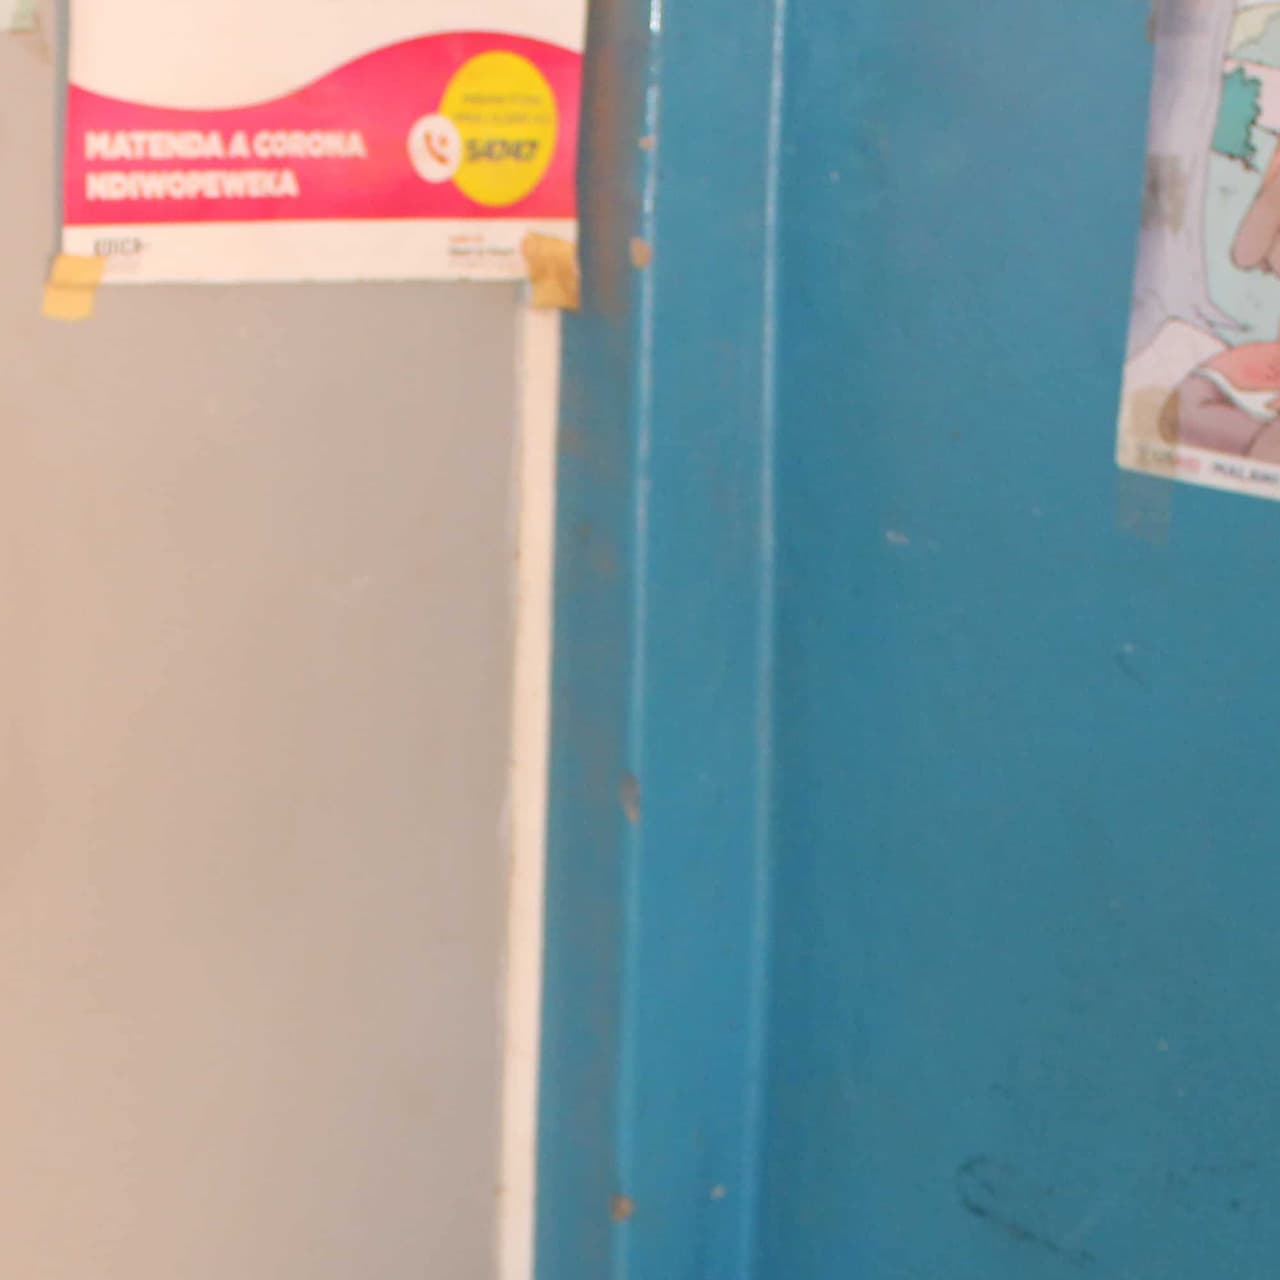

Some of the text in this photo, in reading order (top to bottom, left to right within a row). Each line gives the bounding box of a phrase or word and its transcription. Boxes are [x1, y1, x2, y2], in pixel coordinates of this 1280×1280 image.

[86, 130, 367, 159] MATENDA A CORONA
[86, 169, 299, 199] NDIWOPEWEKA
